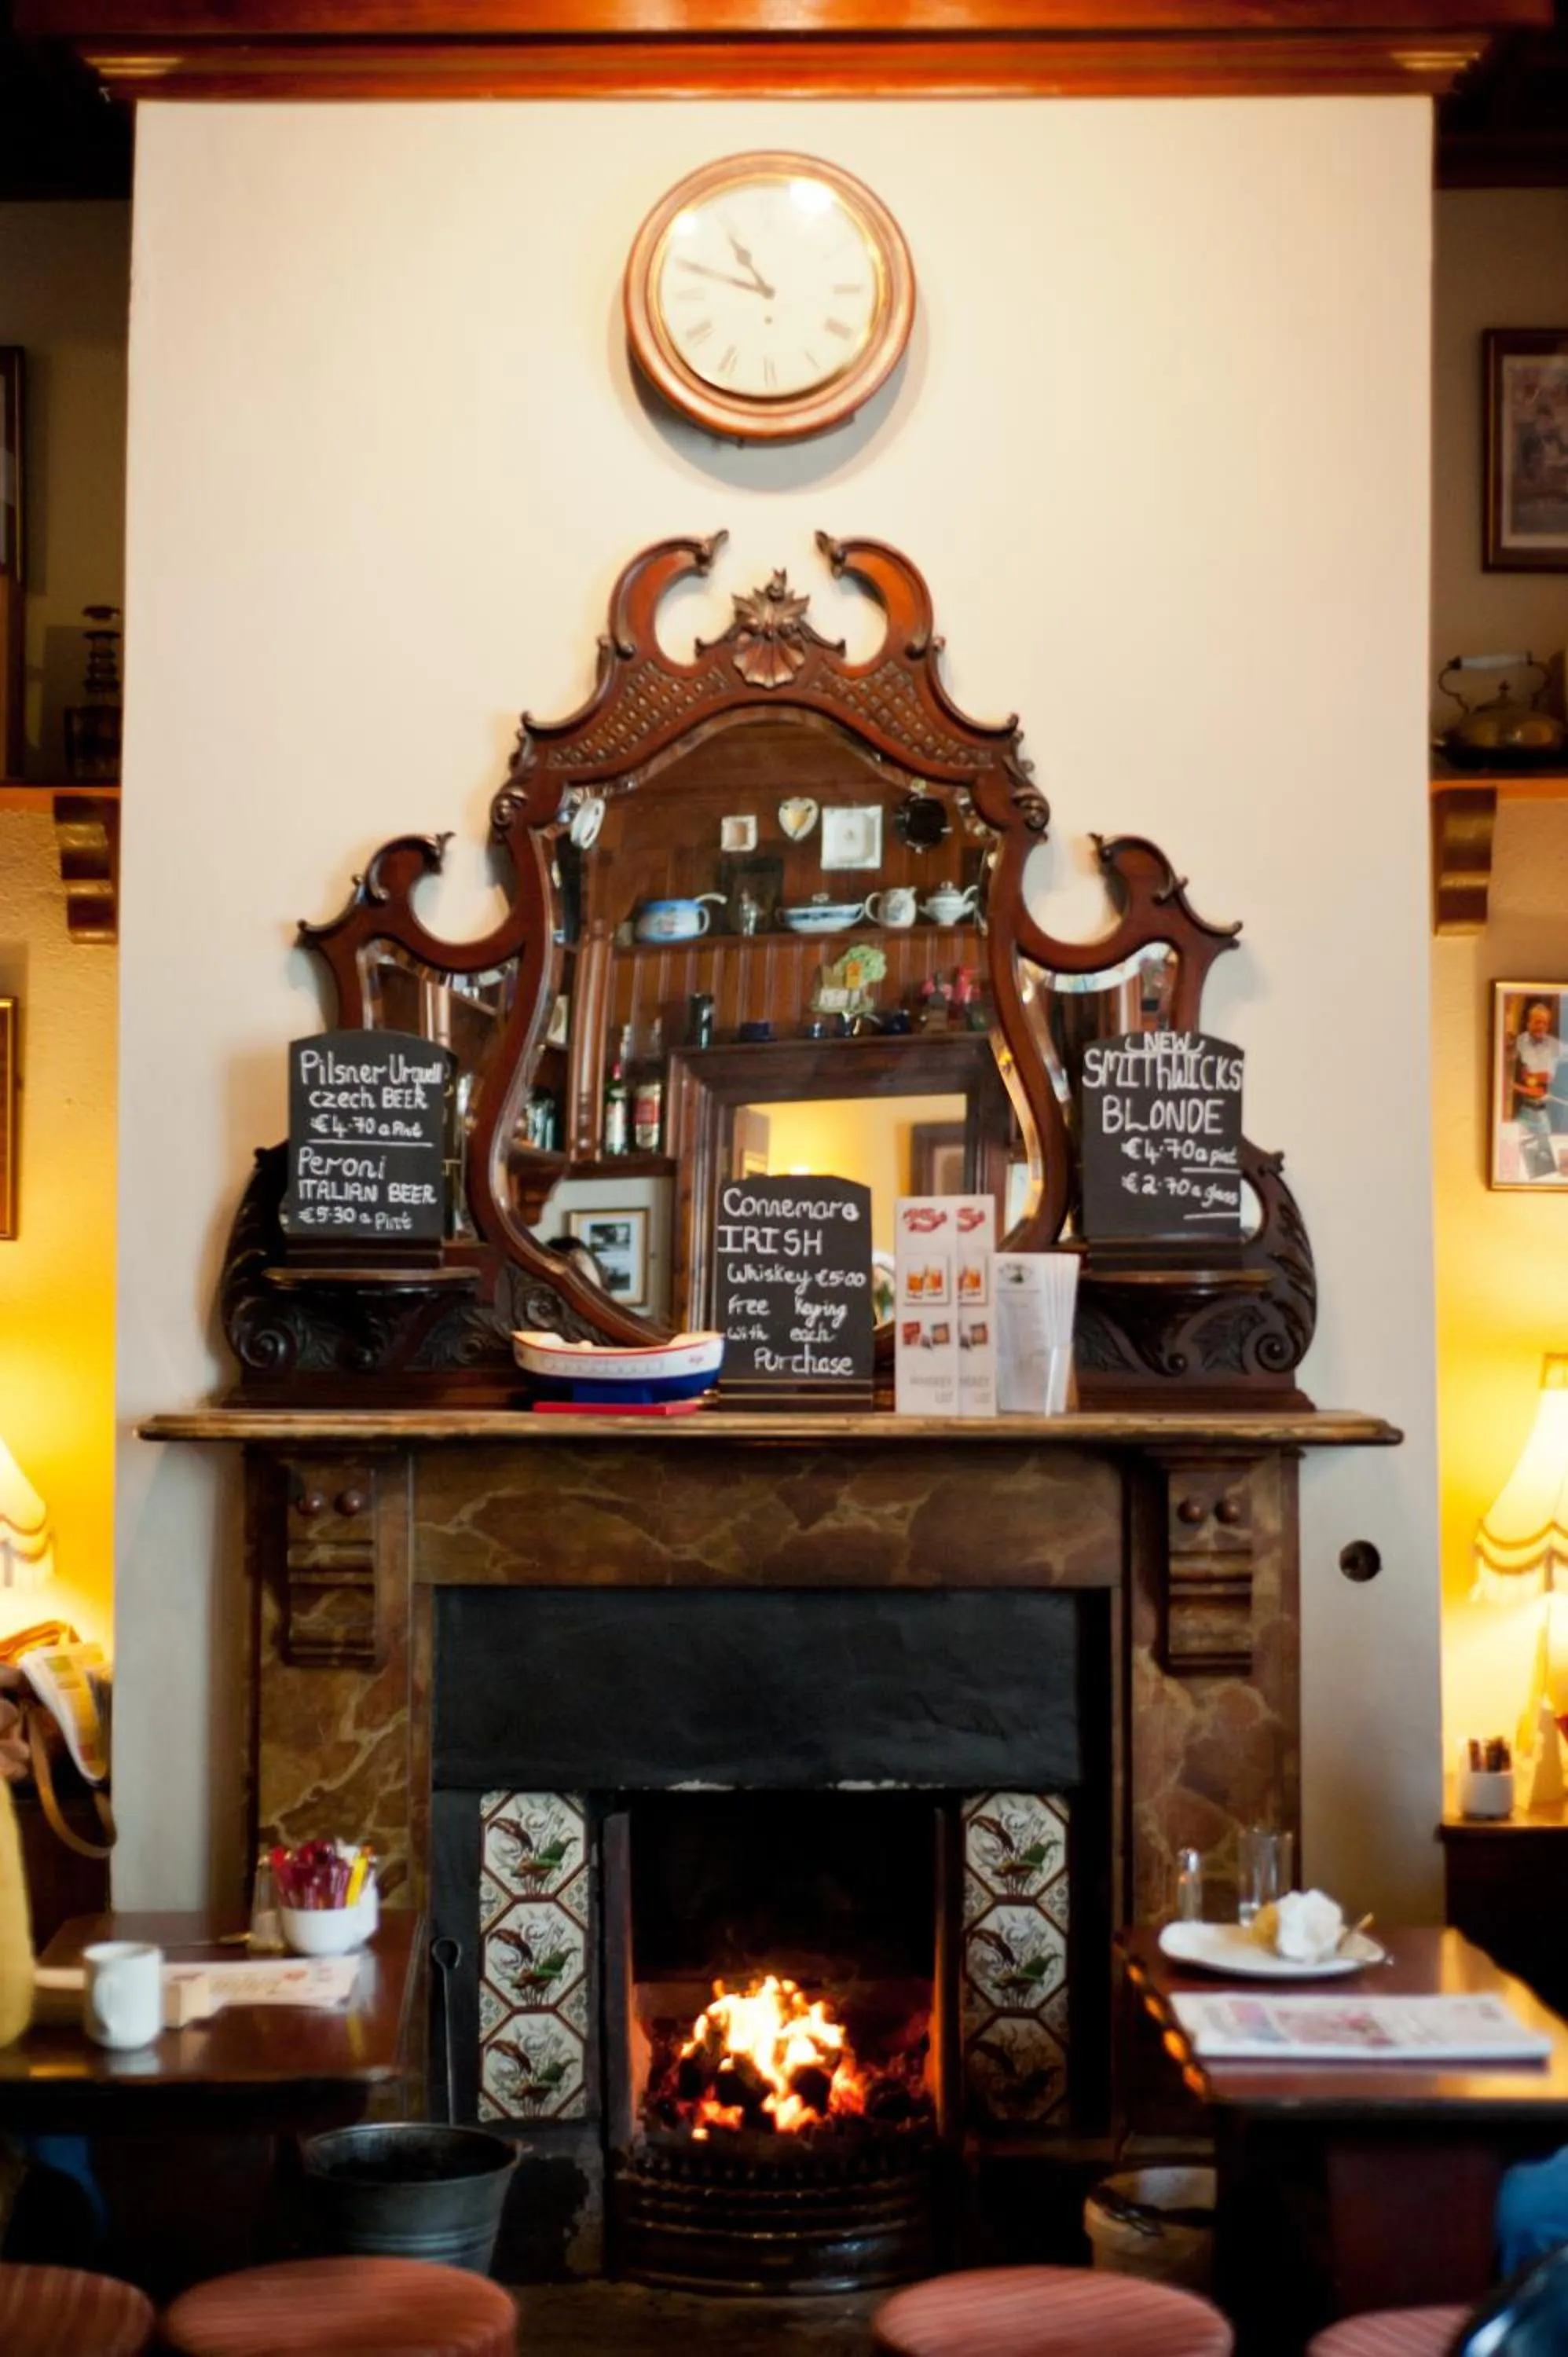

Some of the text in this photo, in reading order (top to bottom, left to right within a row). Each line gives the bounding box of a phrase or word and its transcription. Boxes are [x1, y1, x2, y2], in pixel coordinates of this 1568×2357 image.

[1144, 1031, 1191, 1051] NEW
[300, 1050, 387, 1085] Pilsner
[382, 1086, 428, 1109] BEER
[1102, 1094, 1224, 1134] BLONDE
[298, 1146, 387, 1179] Peroni
[299, 1179, 438, 1204] ITALIAN BEER
[723, 1188, 860, 1222] Connemara
[717, 1225, 822, 1256] IRISH
[727, 1263, 811, 1296] Whiskey
[728, 1294, 770, 1316] Free
[789, 1321, 836, 1342] each
[753, 1343, 854, 1376] Purchase
